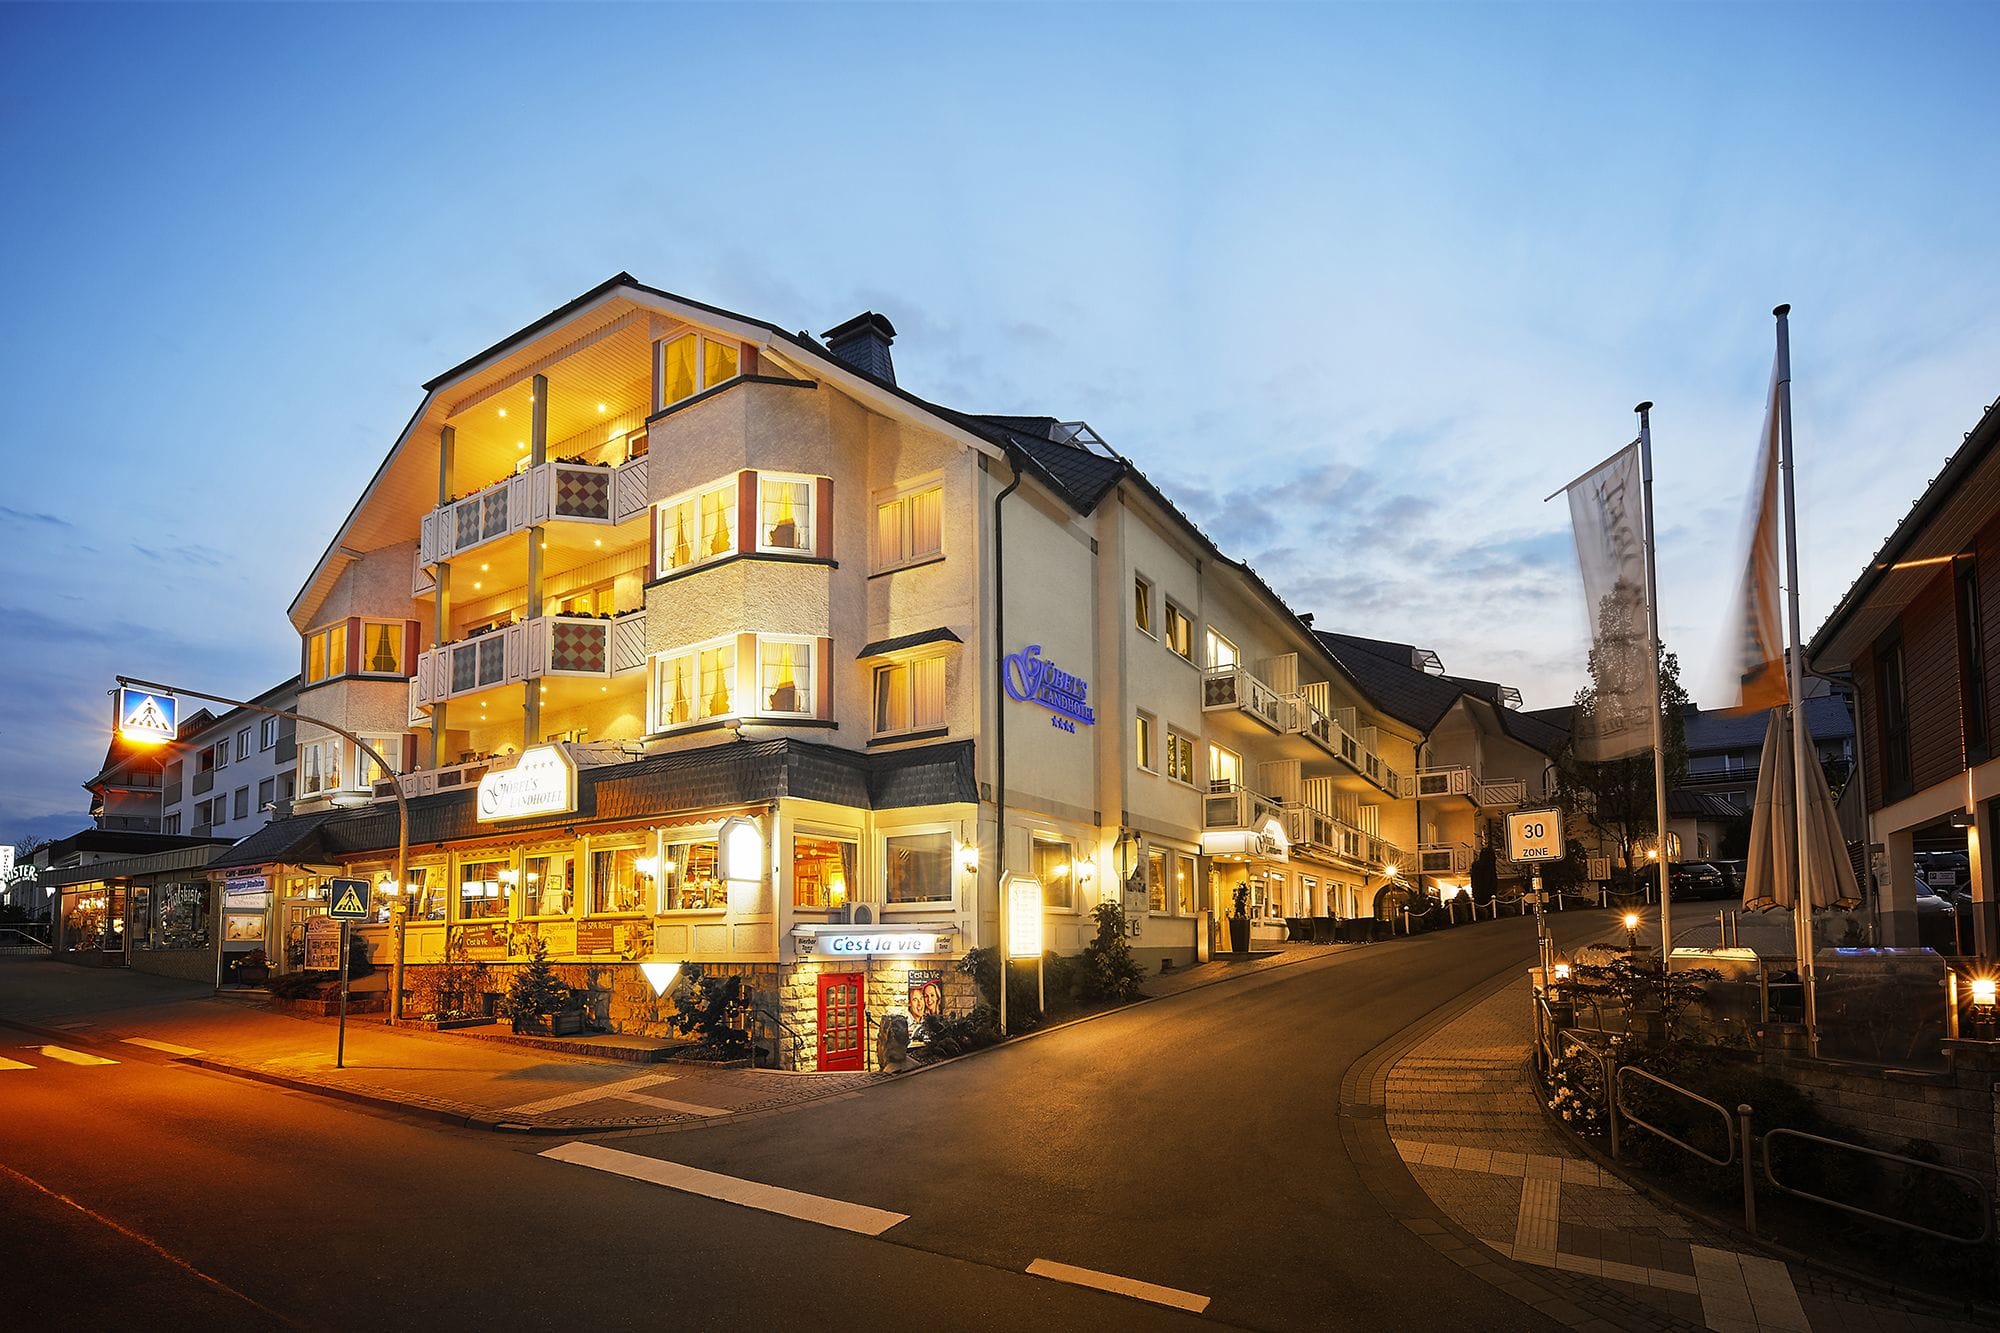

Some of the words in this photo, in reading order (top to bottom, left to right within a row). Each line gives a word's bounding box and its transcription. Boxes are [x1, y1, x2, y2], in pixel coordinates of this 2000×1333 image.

[1039, 686, 1095, 722] LANDHOTEL
[510, 790, 563, 809] LANDHOTEL
[1524, 823, 1545, 839] 30
[1522, 847, 1549, 857] ZONE
[833, 937, 871, 951] C'est
[875, 937, 892, 951] la
[898, 937, 922, 951] vie
